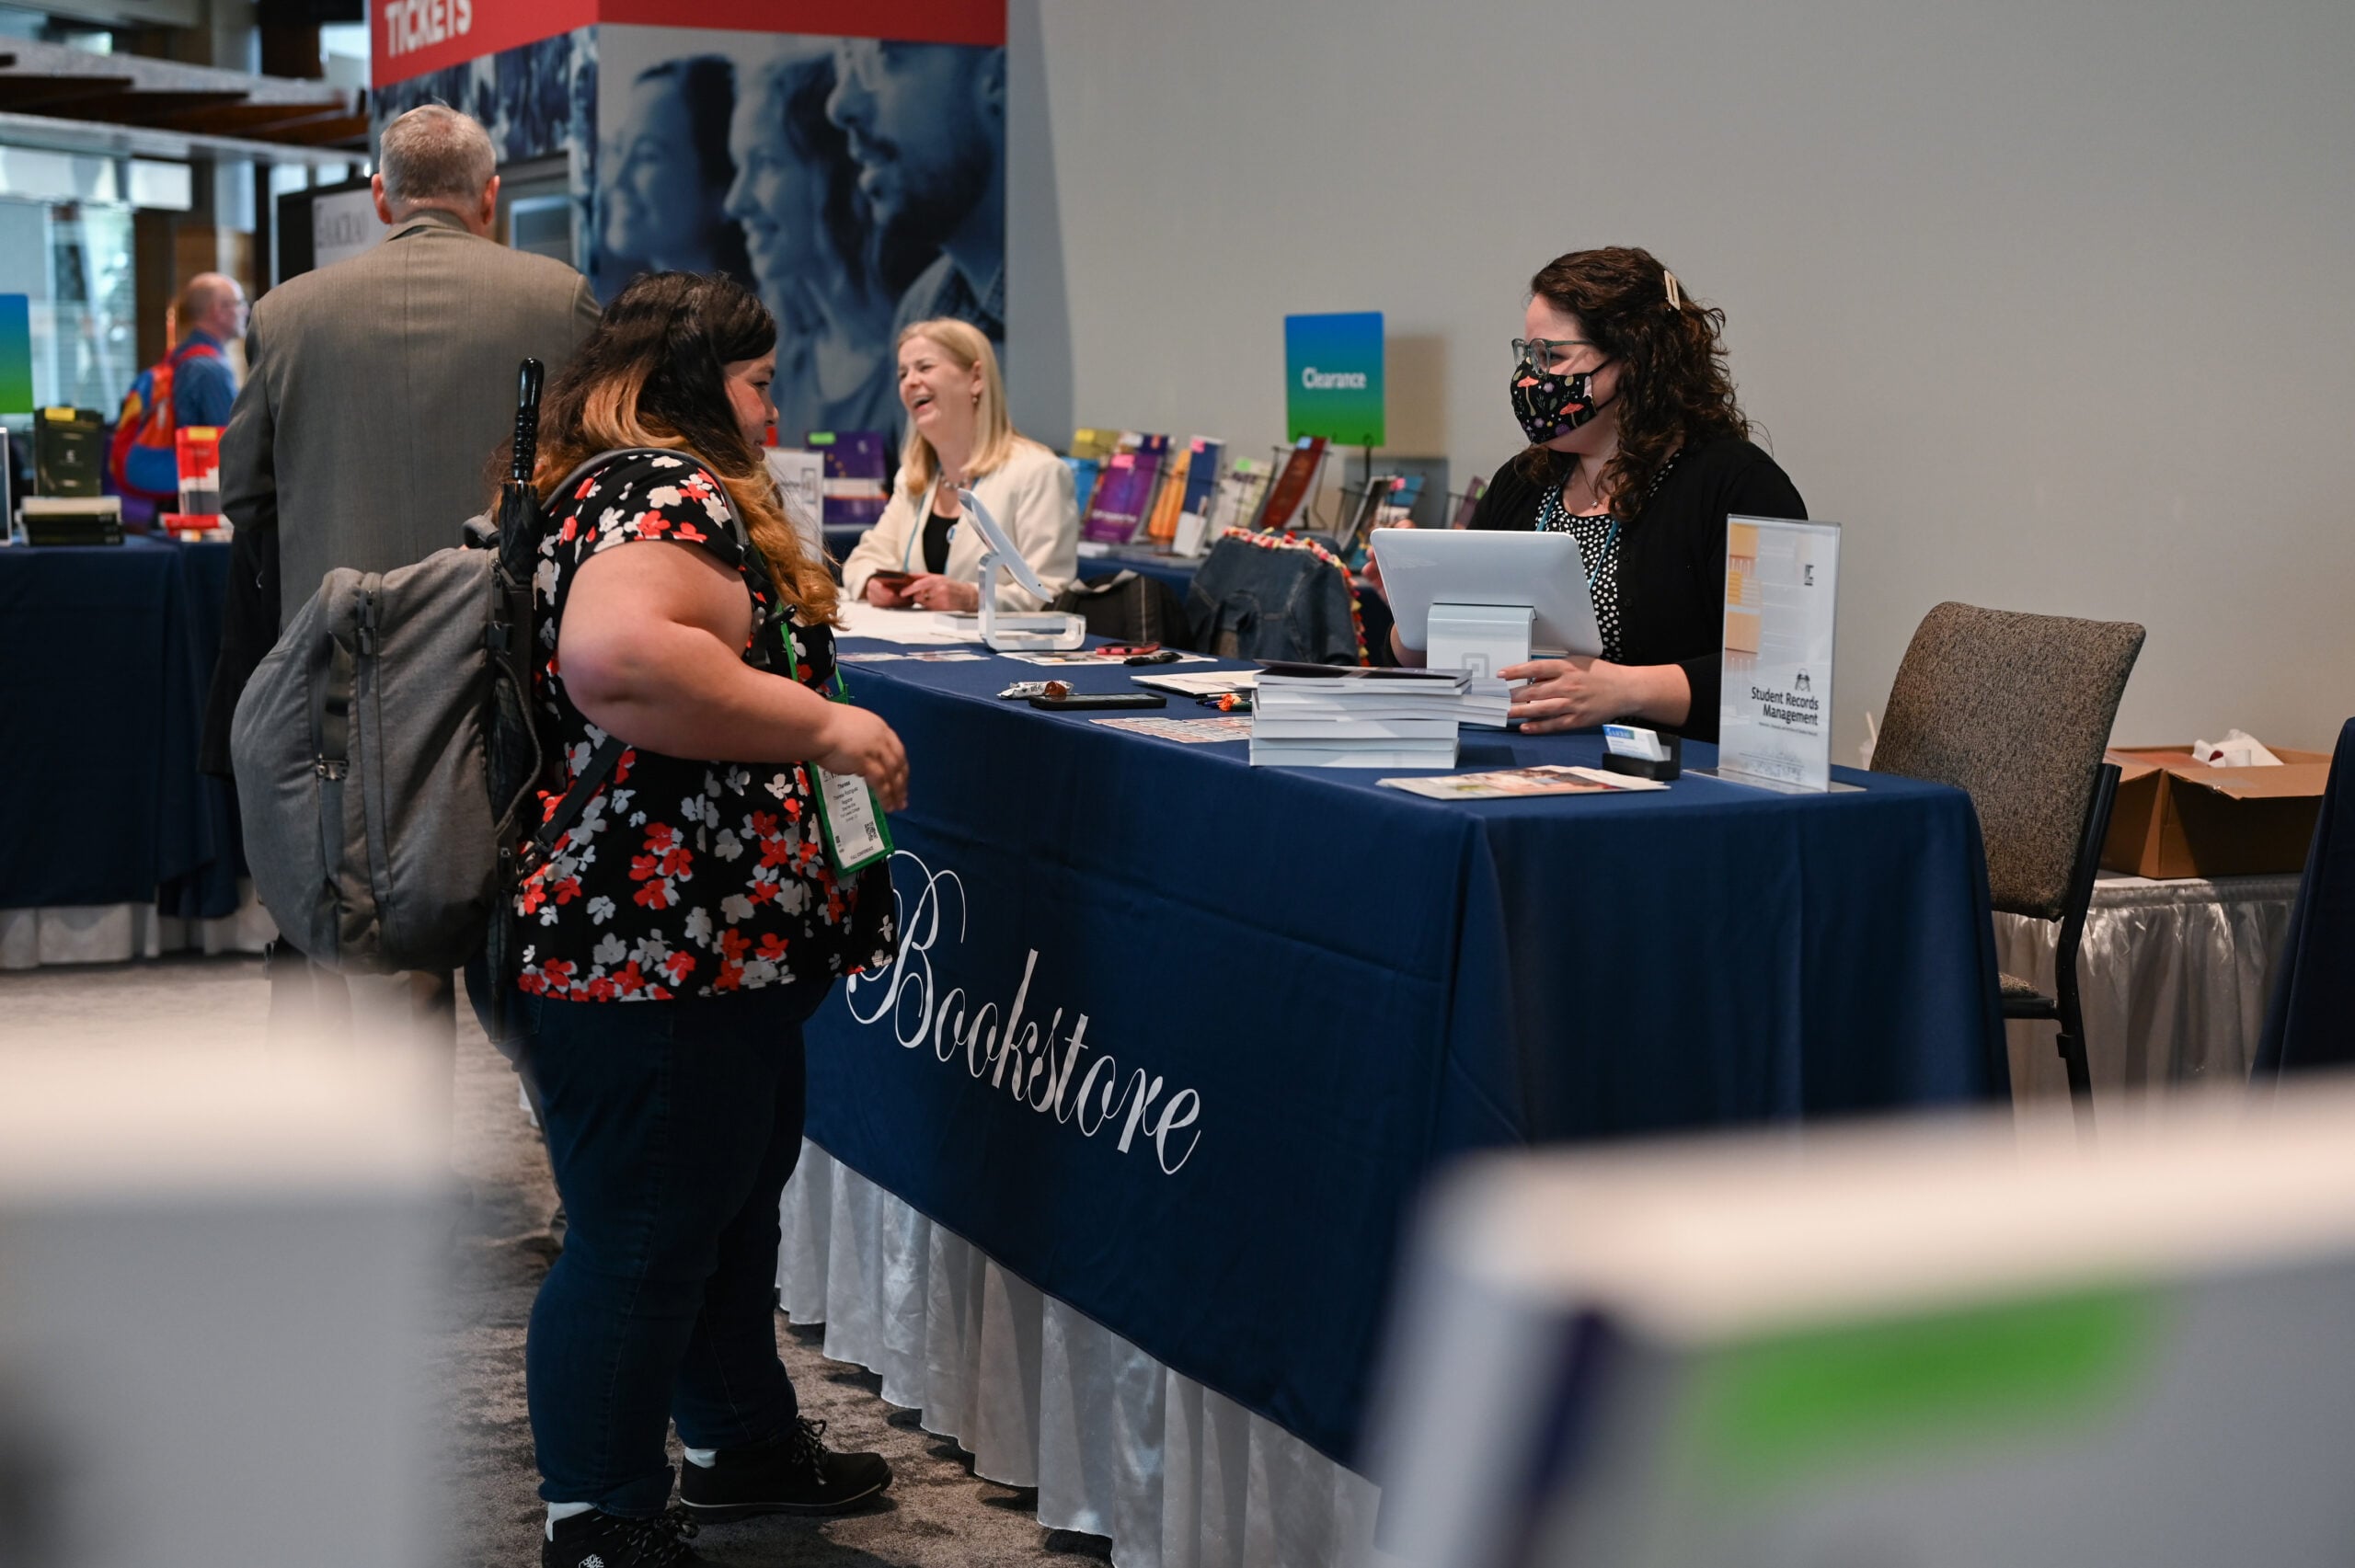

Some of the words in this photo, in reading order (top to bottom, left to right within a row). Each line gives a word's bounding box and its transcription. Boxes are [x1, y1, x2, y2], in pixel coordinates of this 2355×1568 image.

[385, 0, 473, 58] TICKETS
[1302, 367, 1367, 389] Clearance
[1752, 686, 1784, 704] Student
[1786, 692, 1820, 711] Records
[1763, 704, 1819, 726] Management
[846, 850, 1201, 1175] Bookstore
